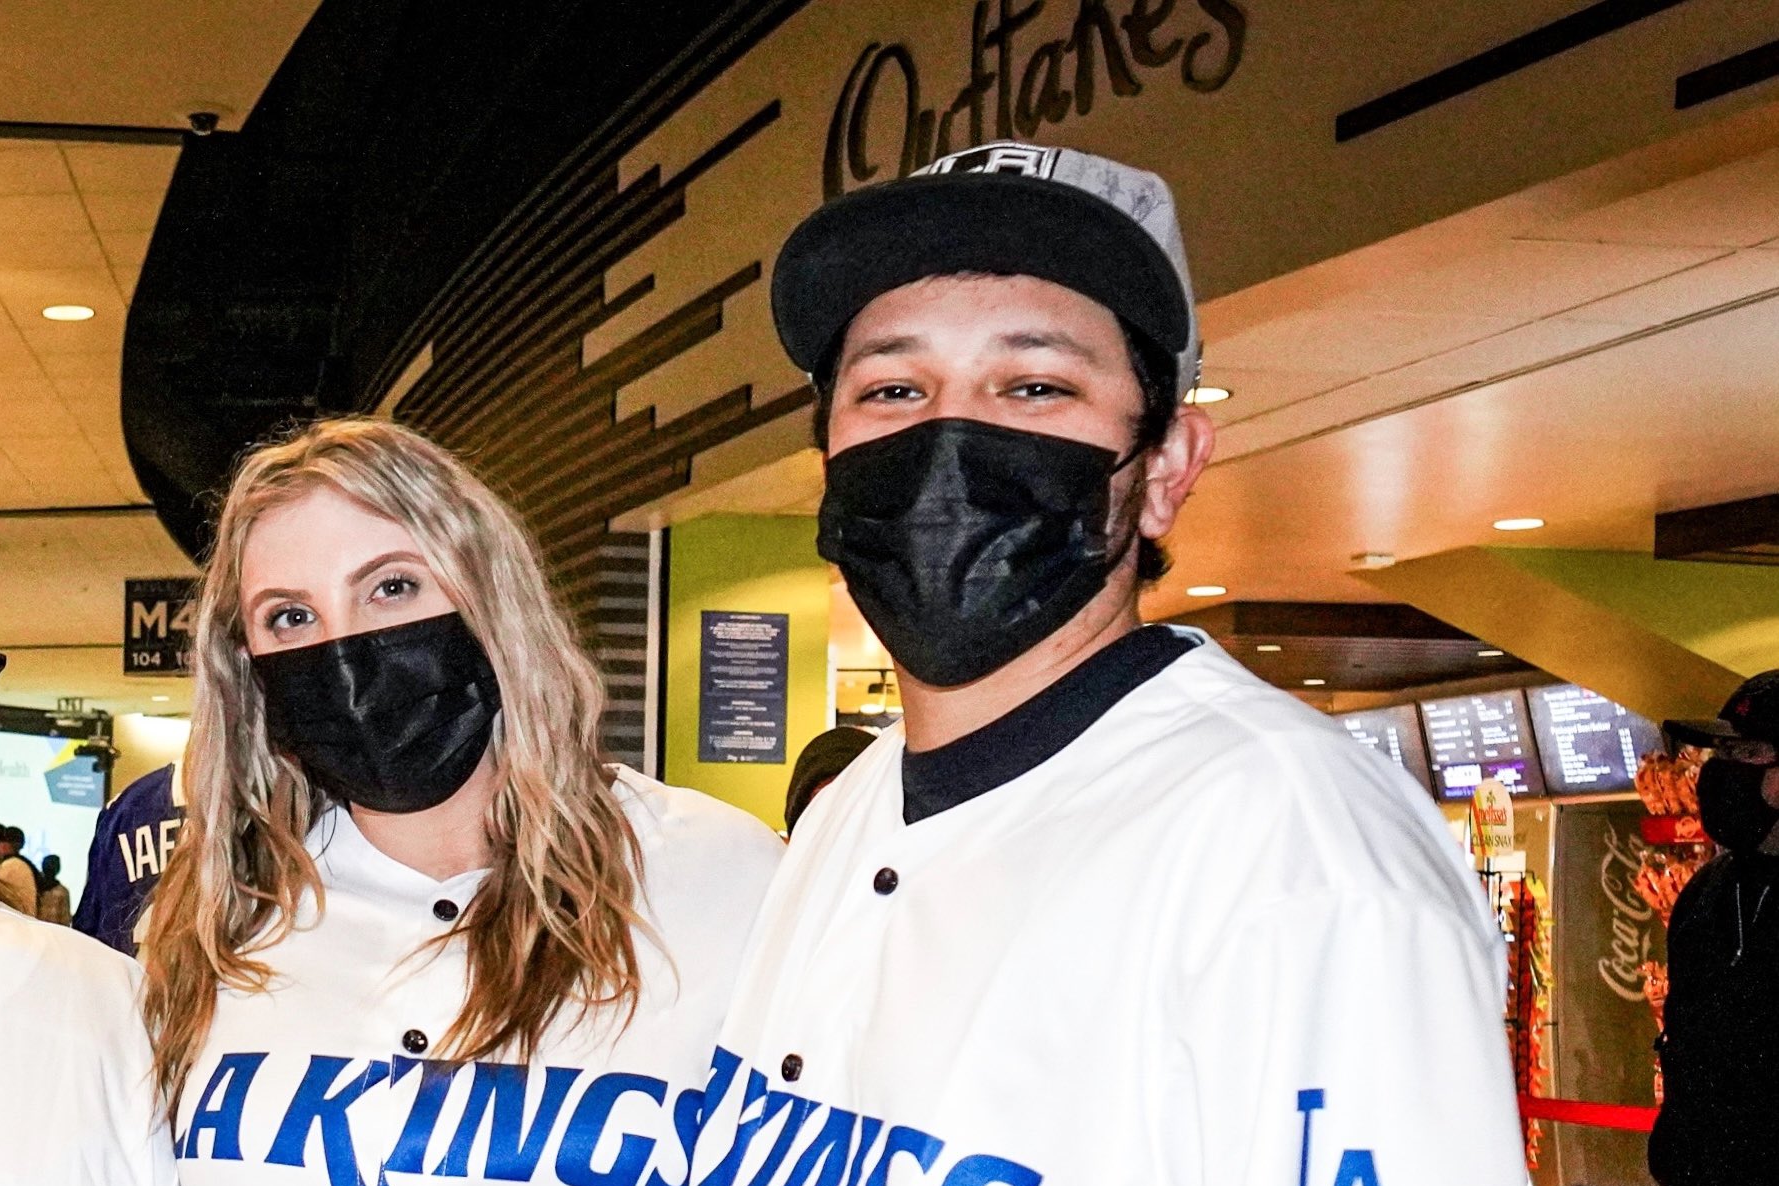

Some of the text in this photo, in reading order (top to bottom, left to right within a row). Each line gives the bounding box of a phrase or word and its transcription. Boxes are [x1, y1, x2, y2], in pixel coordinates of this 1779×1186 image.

[132, 651, 161, 666] 104
[1472, 834, 1494, 848] CLAN
[1598, 819, 1653, 1001] Coca-Cla
[174, 1052, 270, 1161] A
